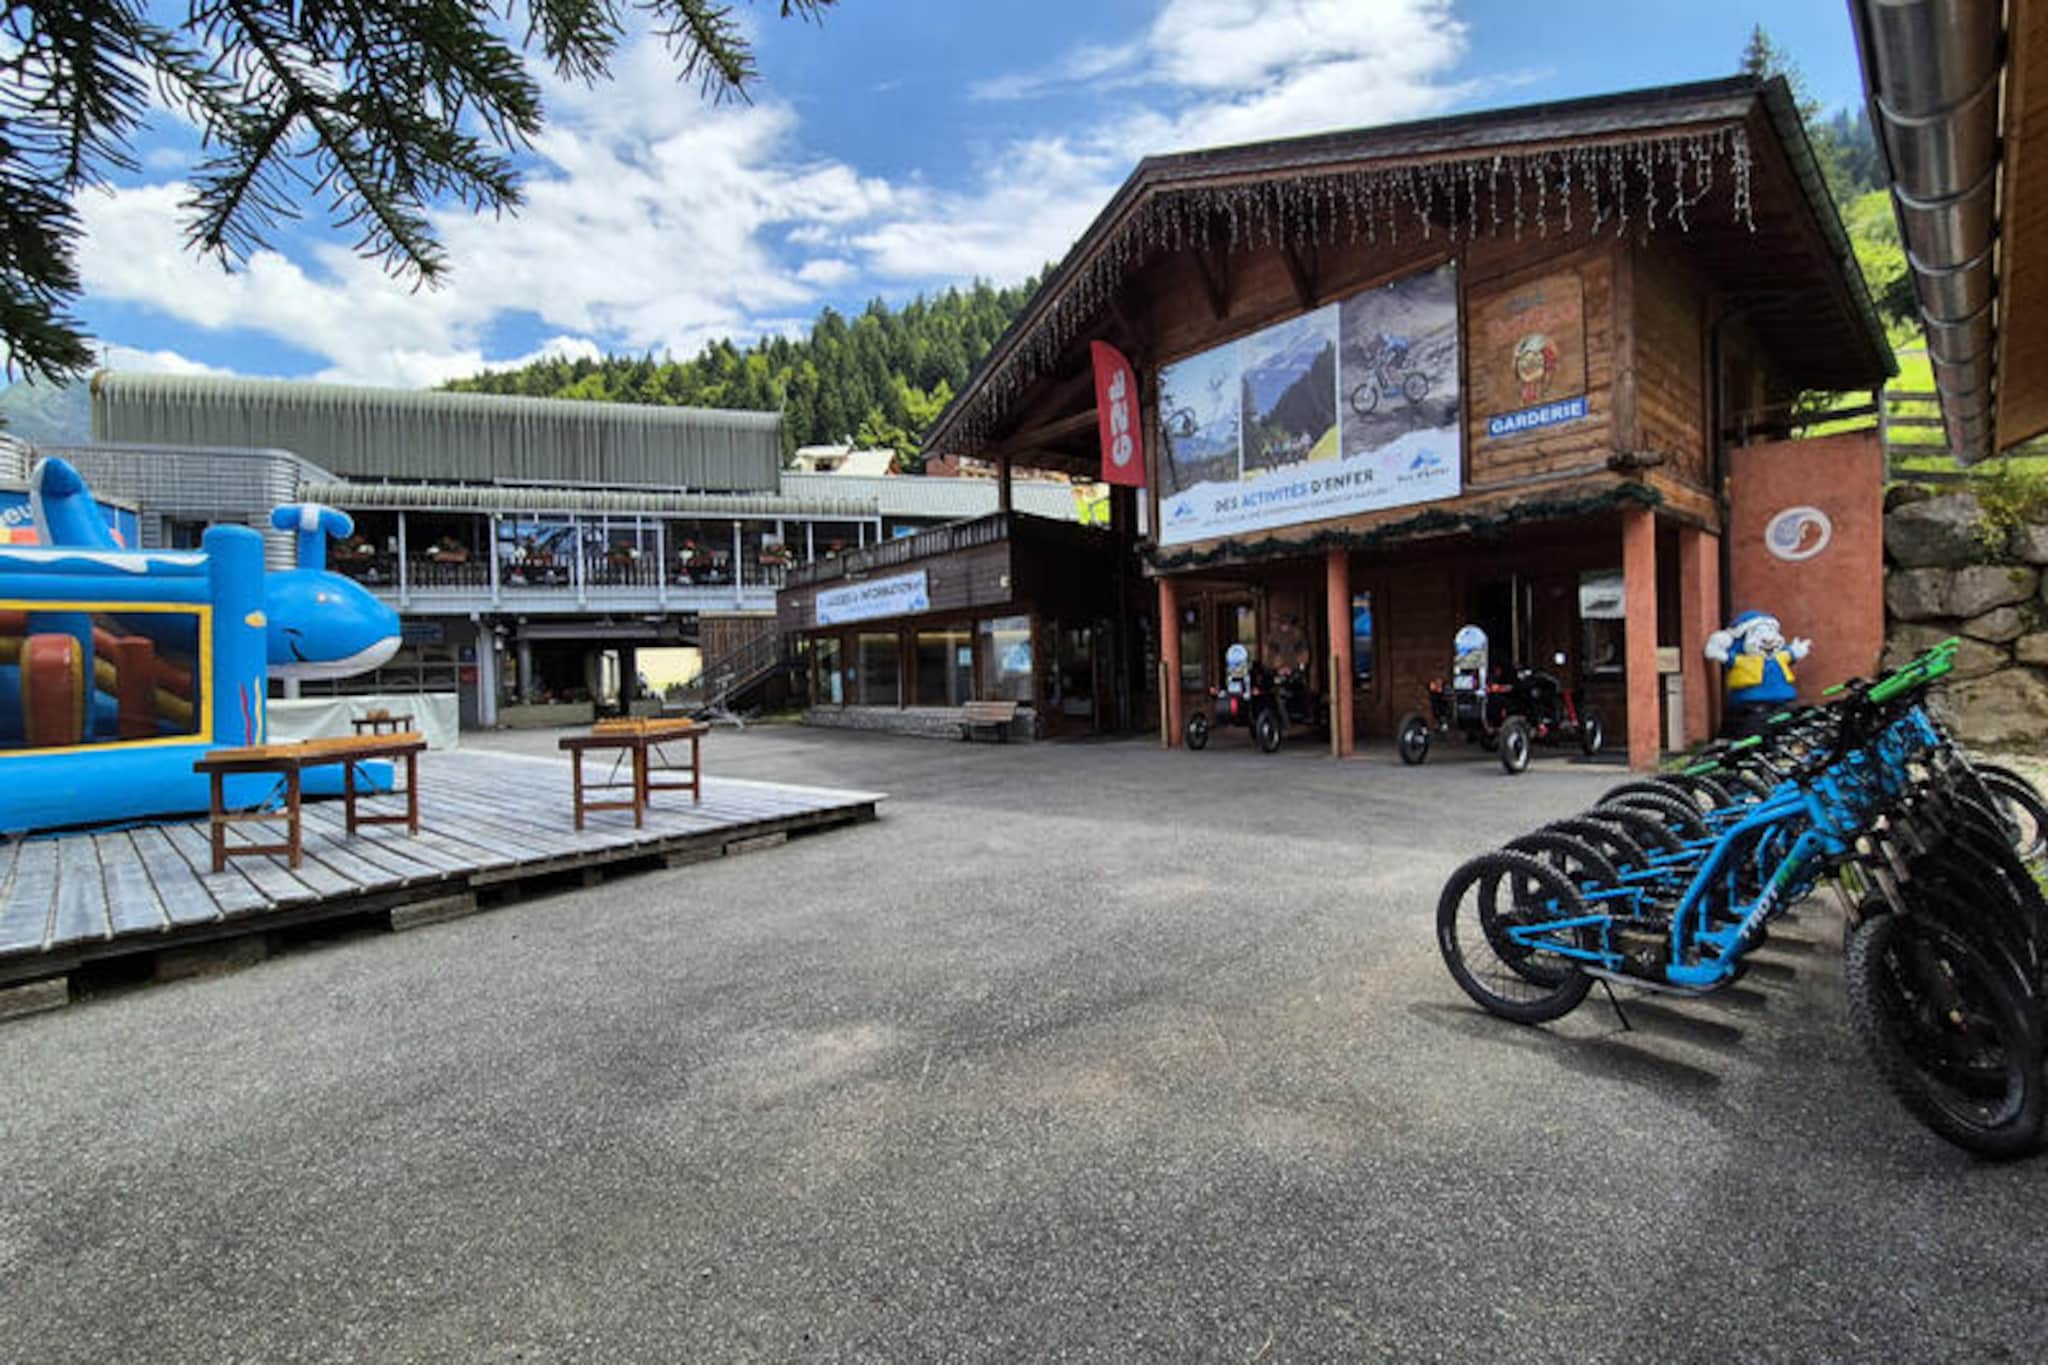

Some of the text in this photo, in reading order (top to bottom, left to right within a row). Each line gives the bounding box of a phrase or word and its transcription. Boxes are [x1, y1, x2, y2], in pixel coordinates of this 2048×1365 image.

[1491, 402, 1582, 434] GARDERIE
[1215, 496, 1238, 513] DES
[1310, 468, 1374, 495] D'ENFER
